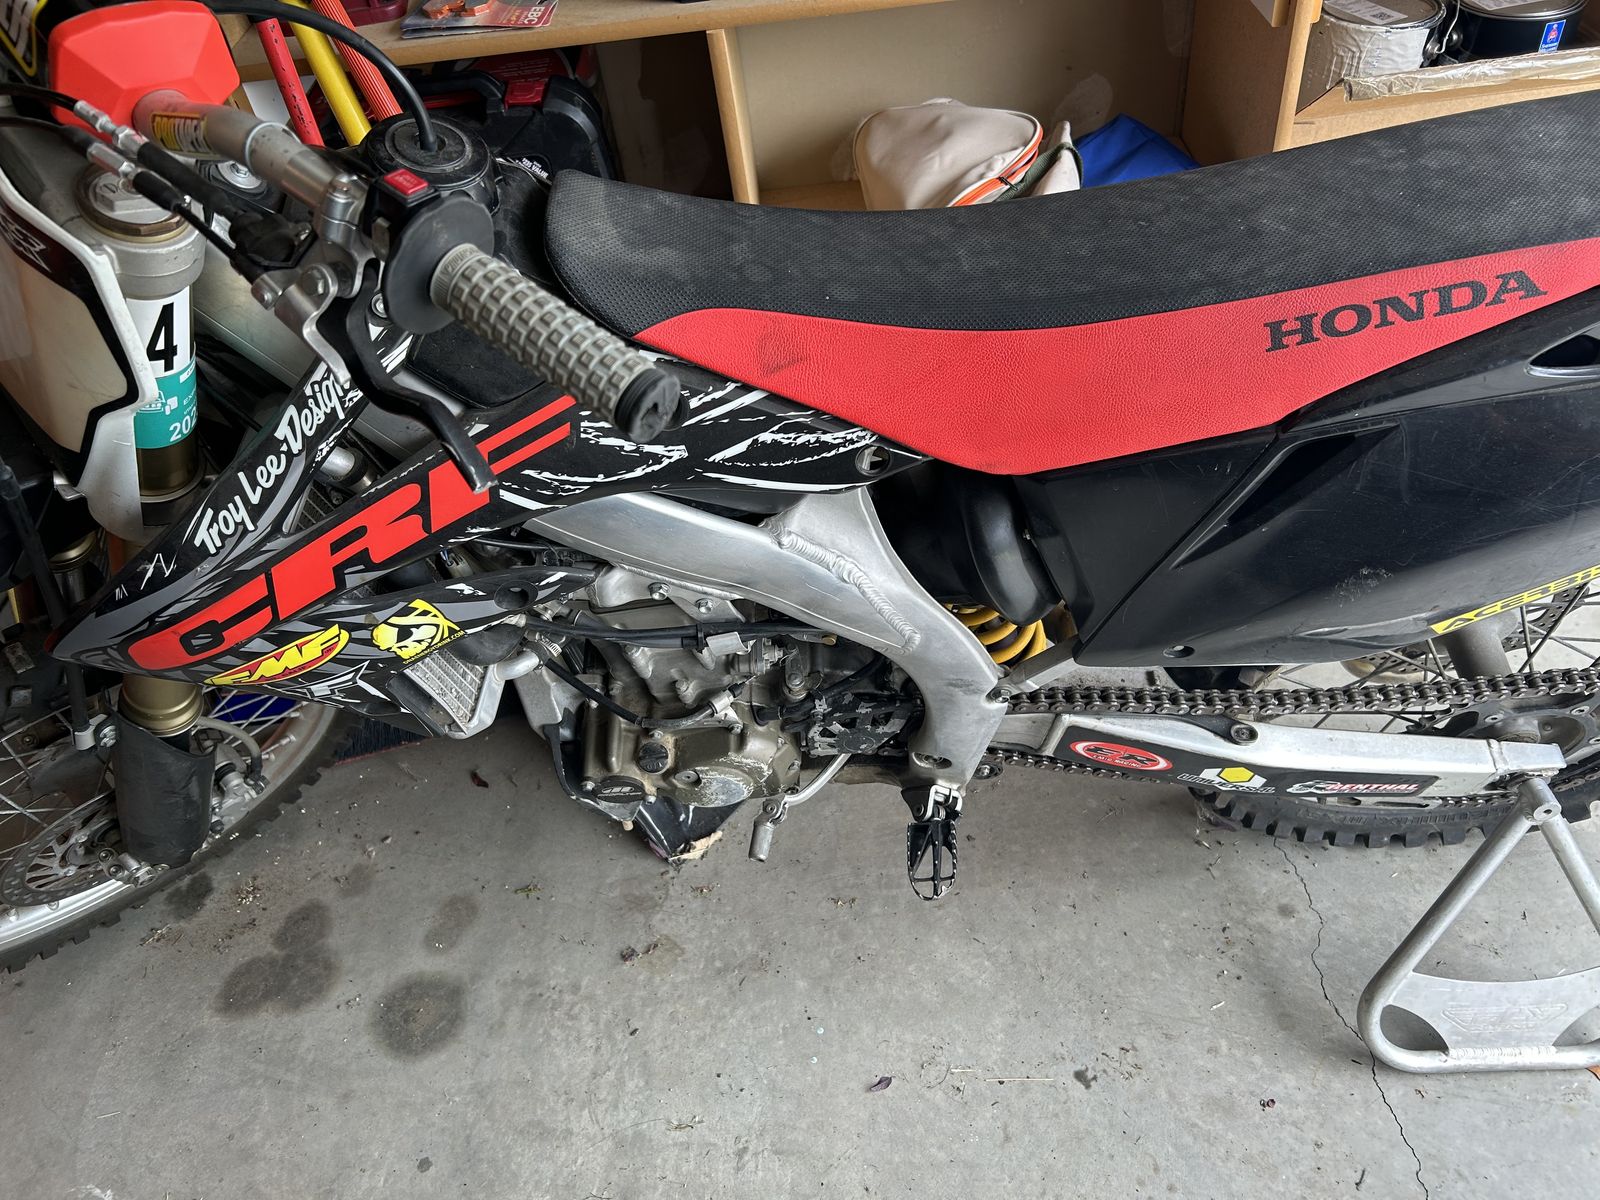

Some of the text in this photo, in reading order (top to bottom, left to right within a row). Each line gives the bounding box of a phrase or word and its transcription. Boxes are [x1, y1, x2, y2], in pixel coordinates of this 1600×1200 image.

[523, 6, 546, 24] EBC
[531, 164, 549, 179] VALUE
[146, 302, 178, 372] 4
[1264, 270, 1549, 353] HONDA
[128, 395, 577, 670] CRF
[194, 495, 255, 554] Troy
[238, 453, 287, 504] Lee
[211, 624, 340, 685] FMF
